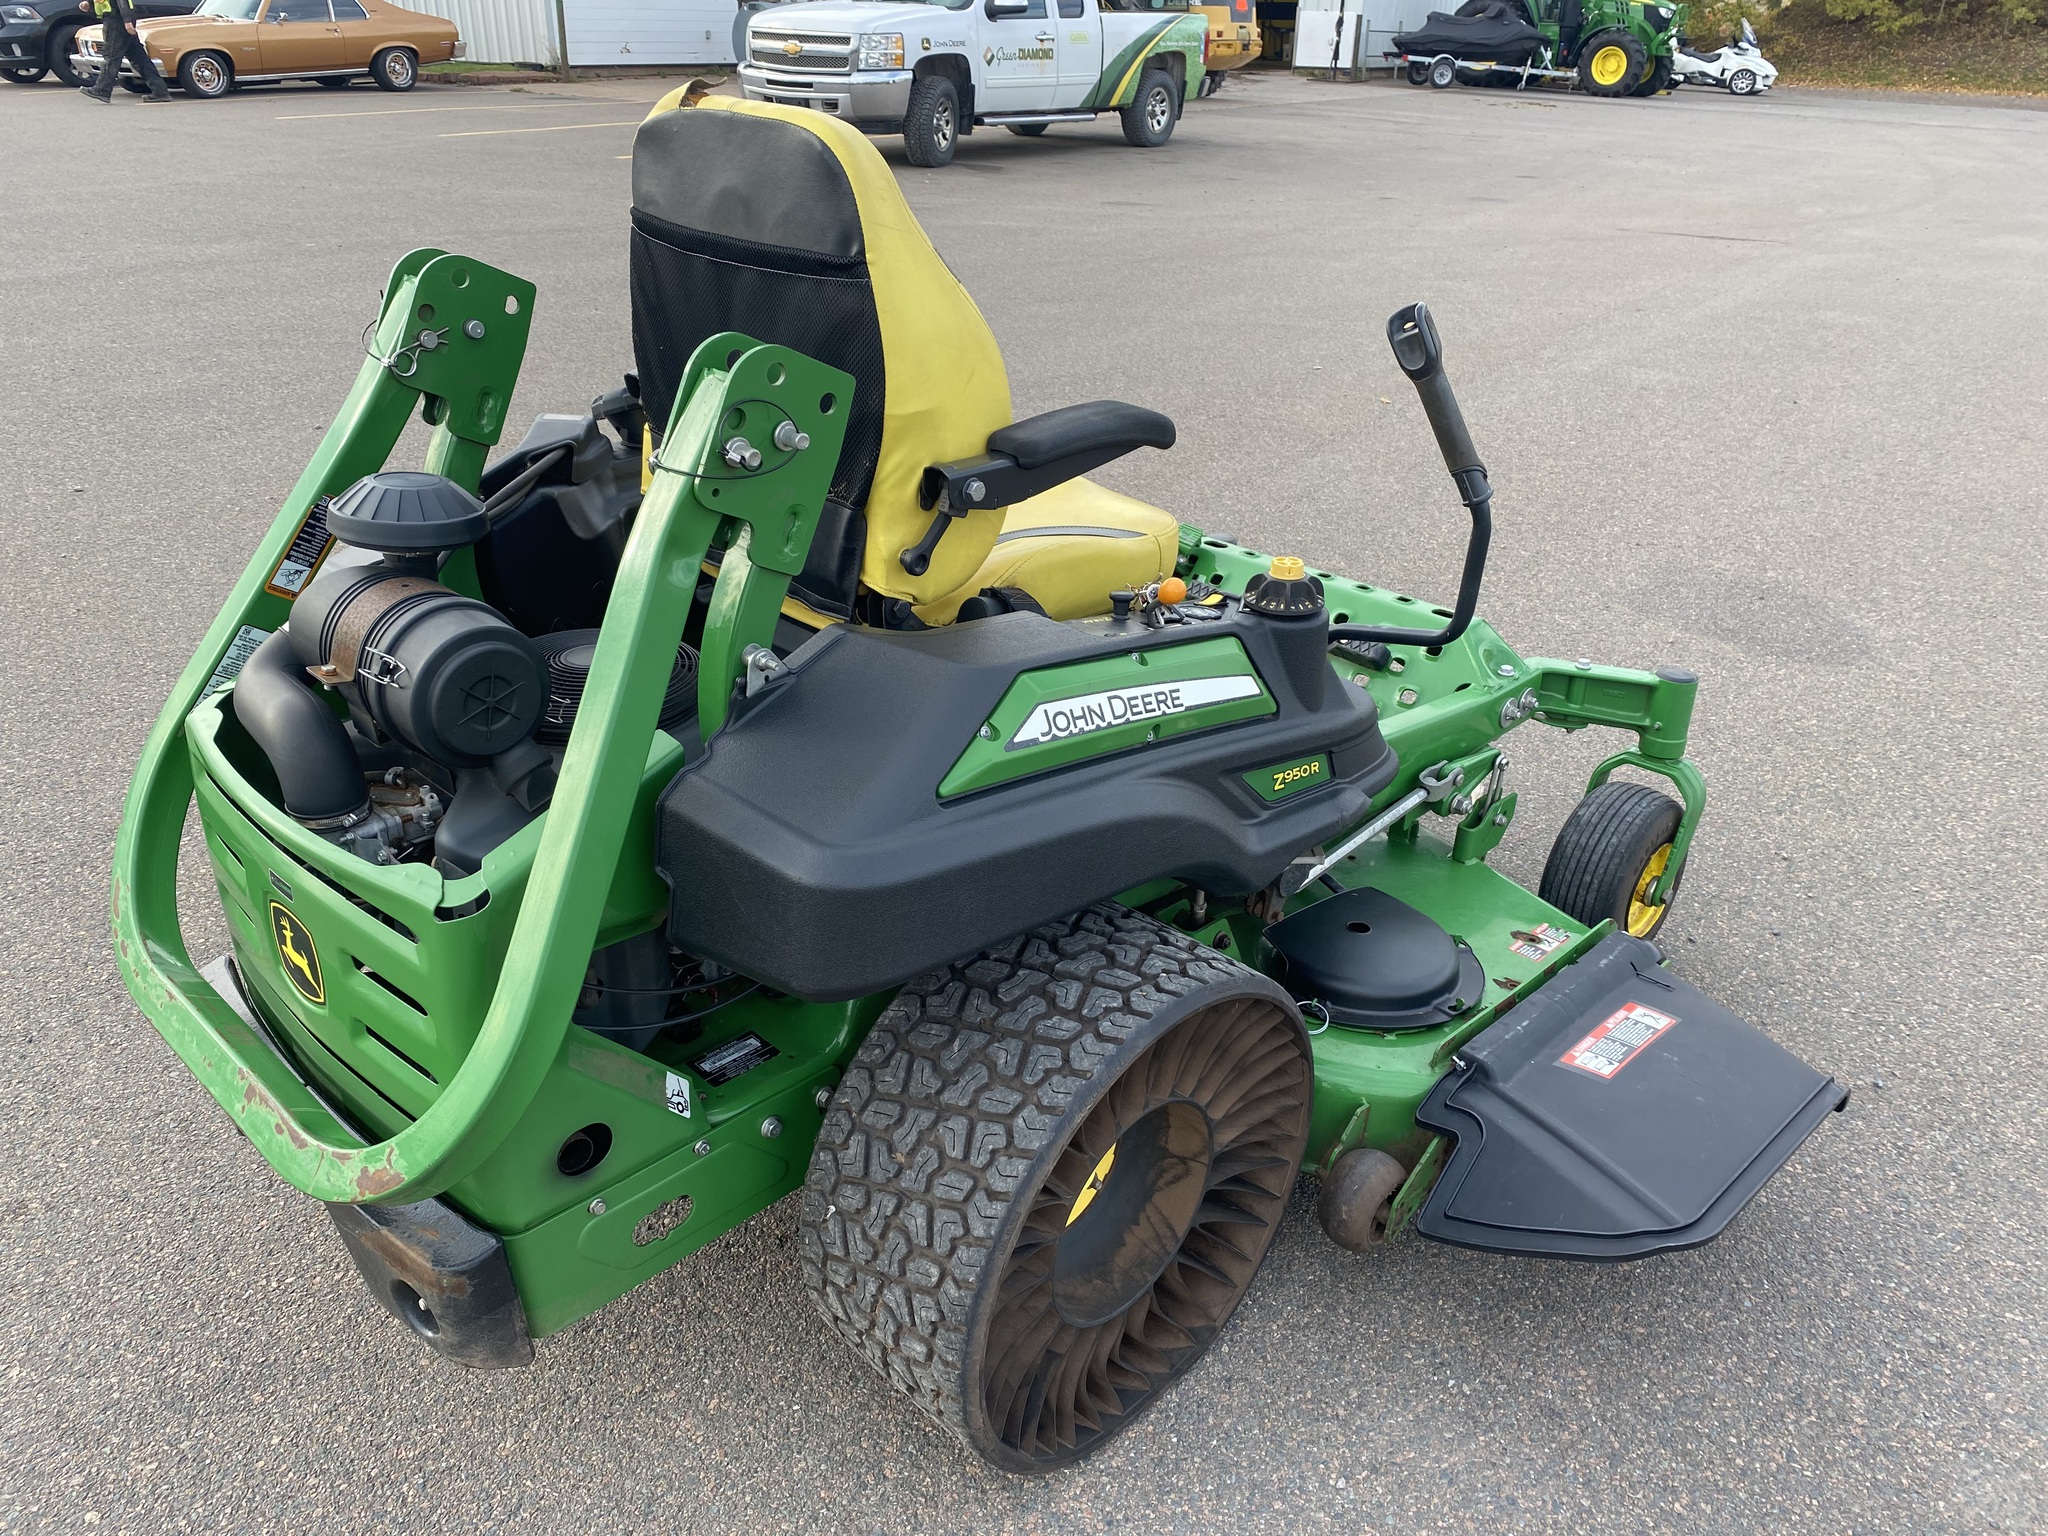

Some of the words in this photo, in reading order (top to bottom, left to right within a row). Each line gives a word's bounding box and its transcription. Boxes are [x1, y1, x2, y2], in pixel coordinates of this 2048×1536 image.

[932, 40, 948, 48] JOHN
[996, 46, 1018, 67] Green
[1018, 48, 1053, 60] DIAMOND
[1040, 701, 1106, 738] JOHN
[1111, 688, 1185, 720] DEERE
[1272, 760, 1321, 792] Z950R
